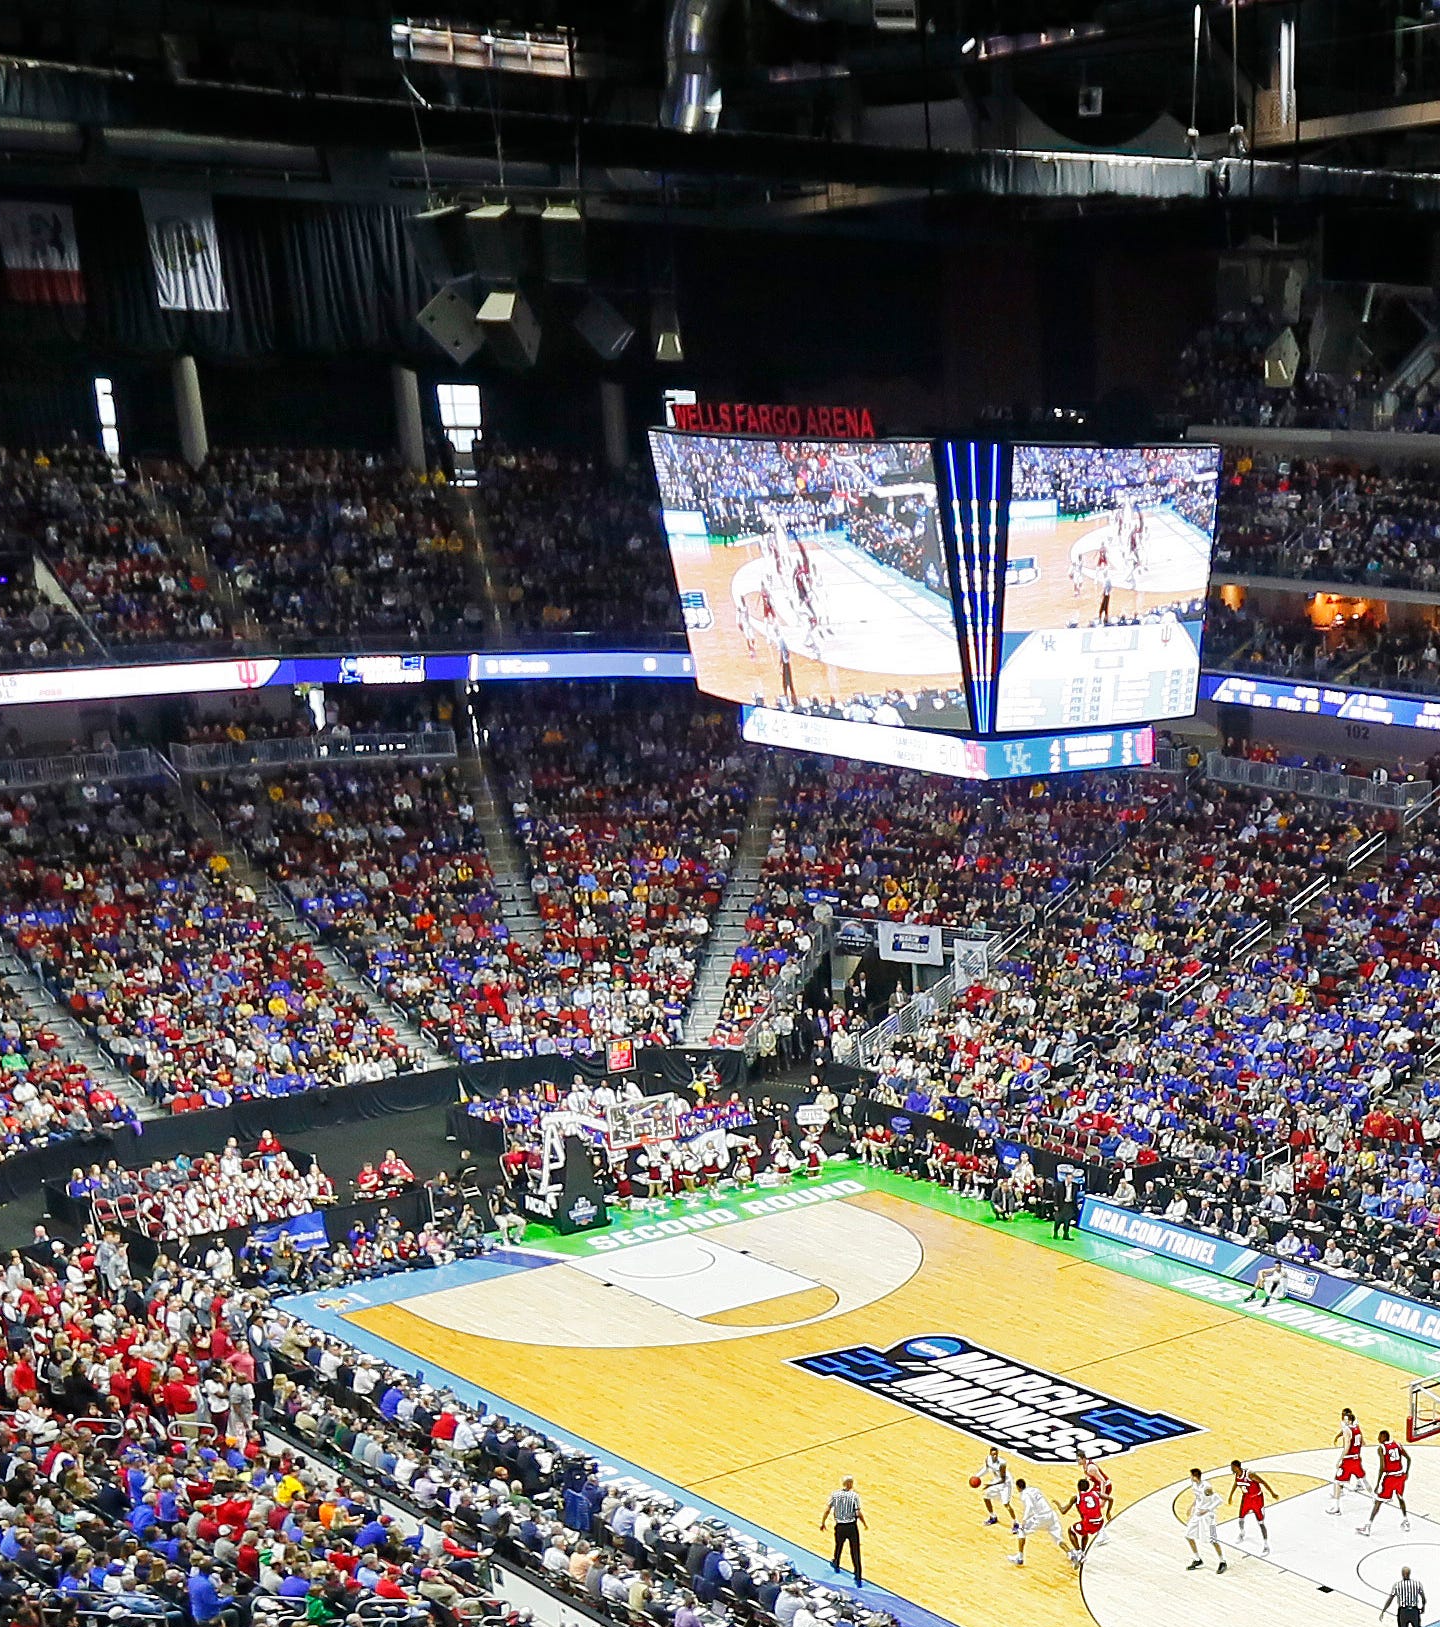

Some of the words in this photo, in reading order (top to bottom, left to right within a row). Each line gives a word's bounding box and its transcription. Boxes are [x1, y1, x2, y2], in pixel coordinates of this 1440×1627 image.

[673, 402, 732, 432] WELLS
[734, 403, 802, 435] FARGO
[807, 406, 876, 438] ARENA
[1345, 725, 1369, 739] 102
[585, 1207, 739, 1251] SECOND
[740, 1178, 866, 1216] ROUND
[1089, 1207, 1217, 1265] NCAA.COM/TRAVEL
[1170, 1275, 1248, 1303] DES
[1237, 1300, 1388, 1348] MOINES
[927, 1350, 1110, 1417] MARCH
[888, 1370, 1124, 1460] MADNESS
[1085, 1496, 1097, 1509] 3
